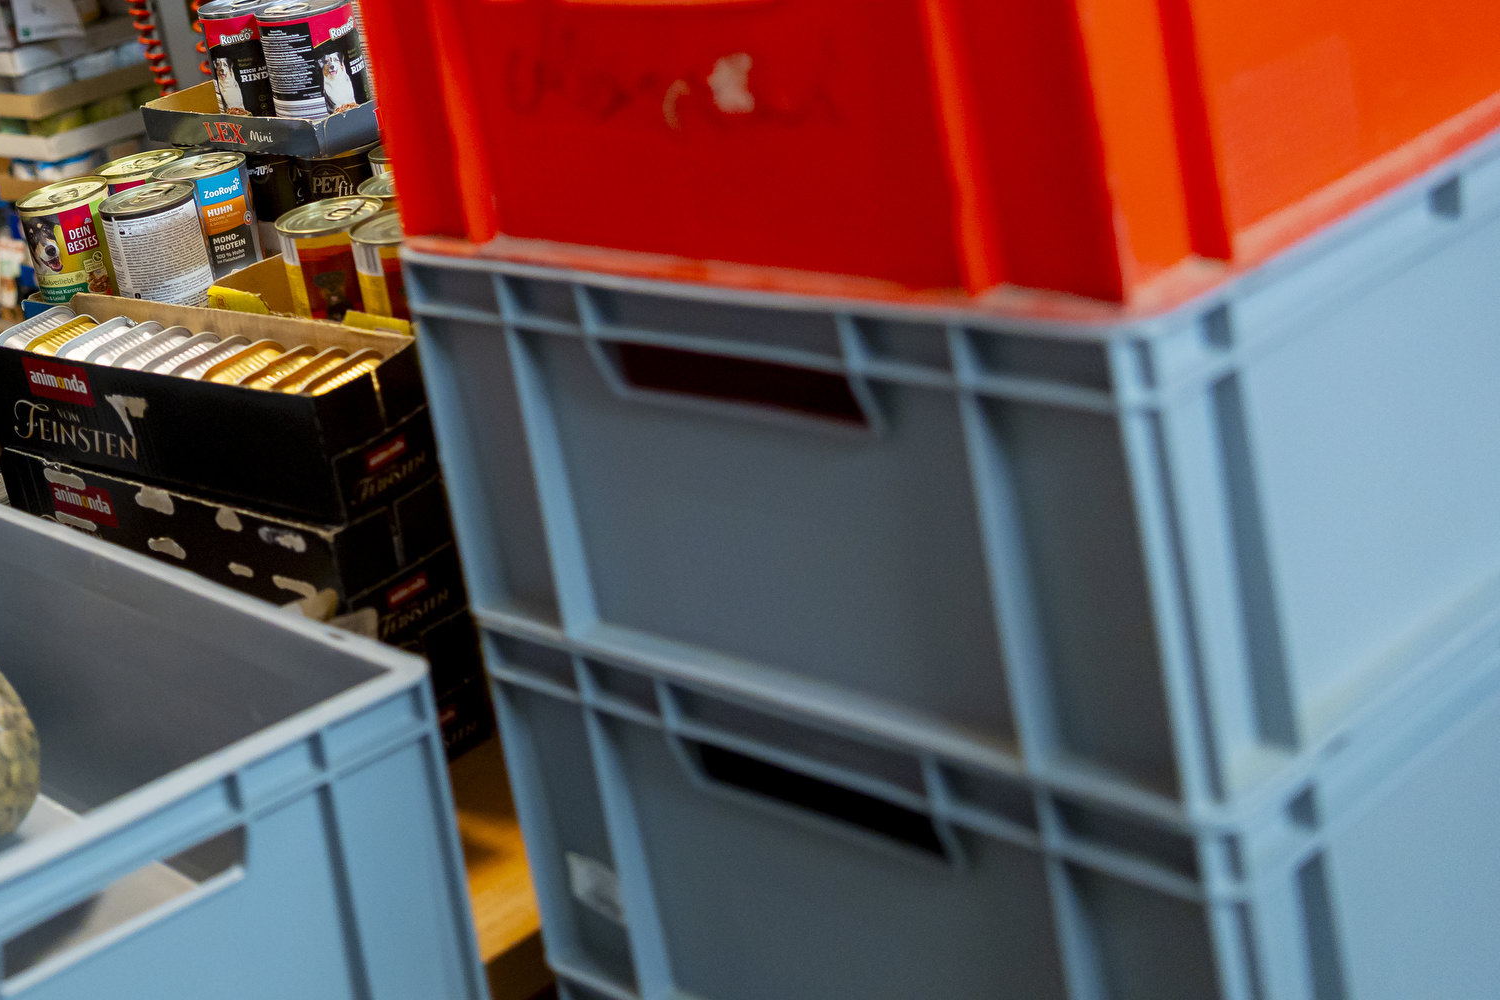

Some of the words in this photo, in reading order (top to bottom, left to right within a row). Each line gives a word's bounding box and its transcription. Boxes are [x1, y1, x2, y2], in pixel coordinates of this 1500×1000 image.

[219, 30, 251, 46] Romeo
[240, 71, 268, 82] RIND
[203, 122, 247, 145] LEX
[250, 130, 273, 143] Mini
[203, 183, 239, 199] ZooRoyal
[206, 204, 233, 217] HUHN
[68, 225, 91, 240] DEIN
[212, 233, 239, 244] MONO-
[67, 235, 98, 252] BESTES
[214, 238, 246, 252] PROTEIN
[29, 369, 88, 395] animonda
[53, 487, 112, 515] animonda
